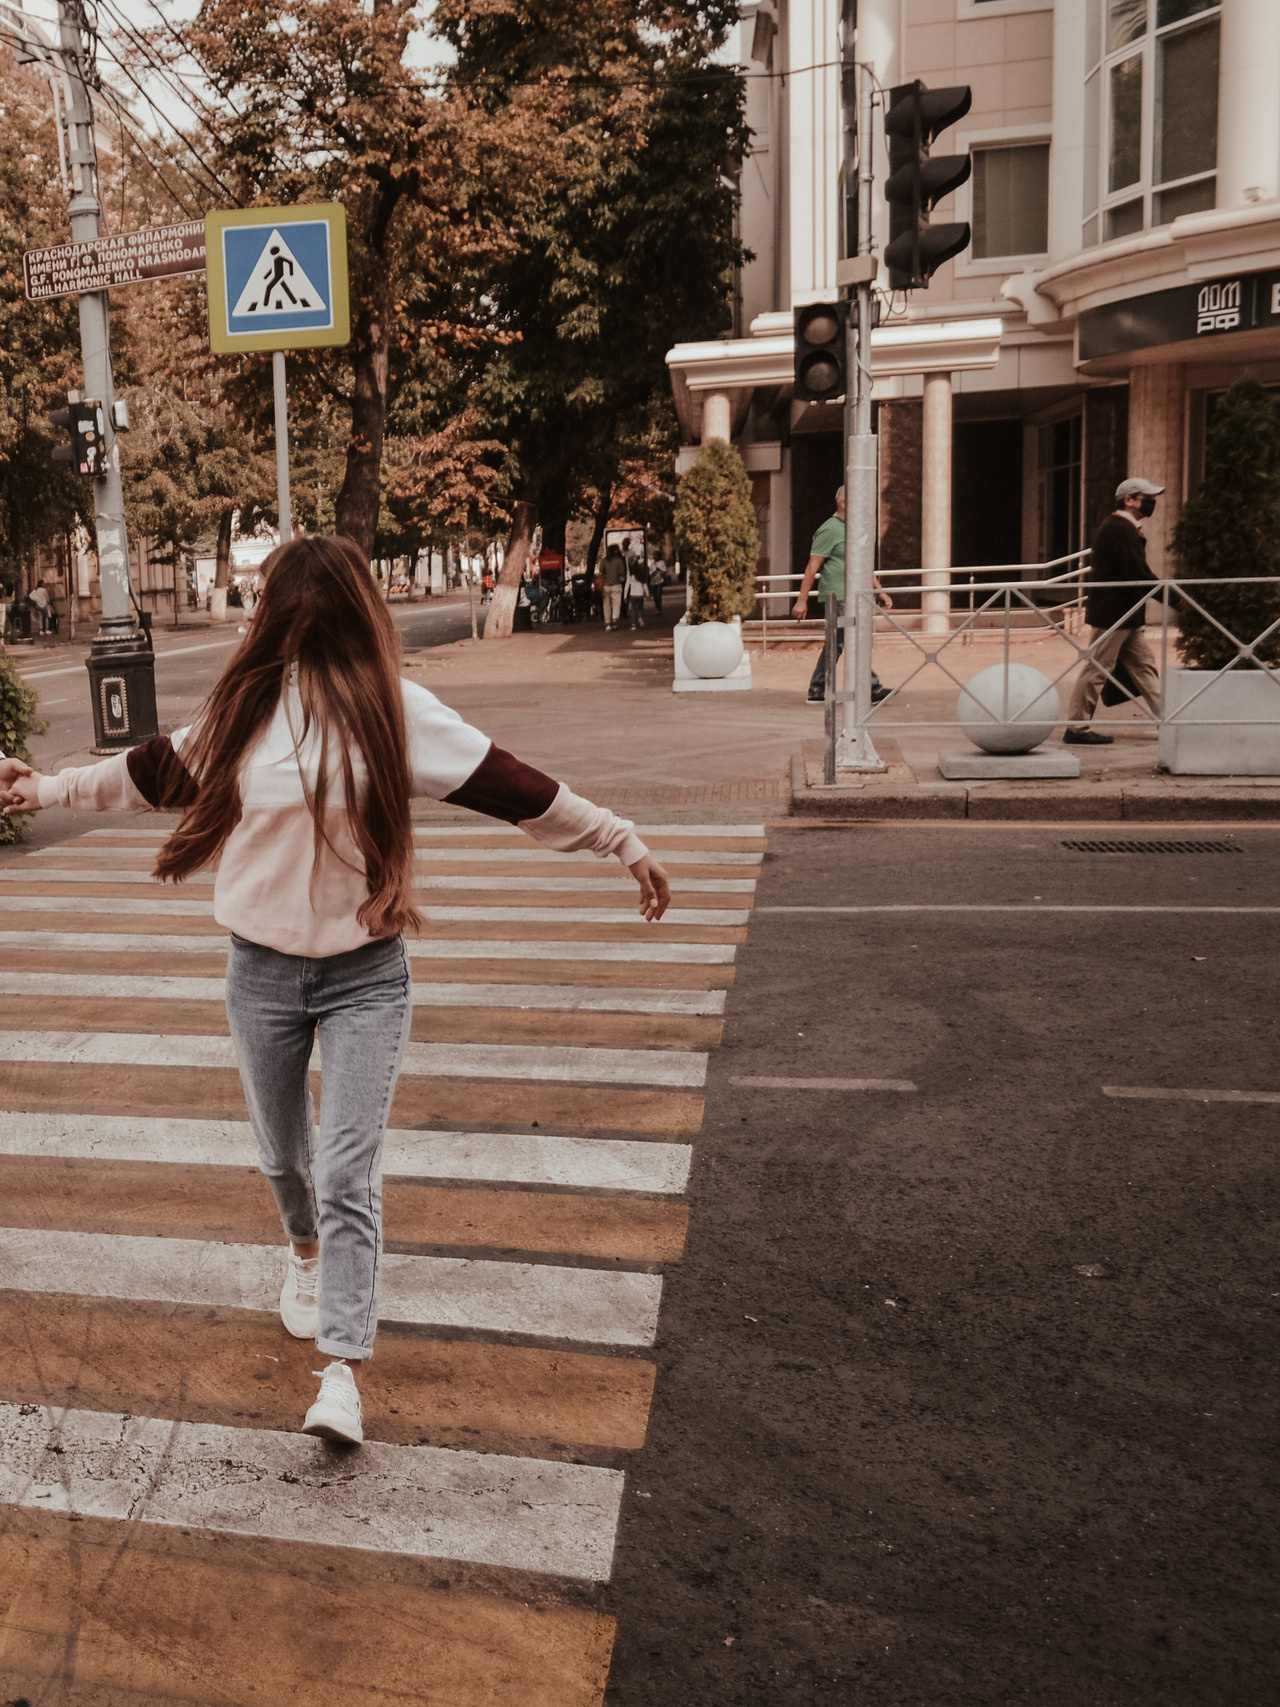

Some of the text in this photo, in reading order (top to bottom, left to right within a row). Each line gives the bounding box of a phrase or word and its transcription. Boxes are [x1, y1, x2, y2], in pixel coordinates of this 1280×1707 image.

[28, 237, 125, 264] КРАСНОДАРСКАЯ
[30, 258, 67, 275] ИМЕНИ
[82, 254, 95, 265] Ф.
[97, 238, 183, 262] ПОНОМАРЕНКО
[30, 245, 206, 286] G.F. PONOMARENKO KRASNODAR
[31, 269, 143, 297] PHILHARMONIC HALL
